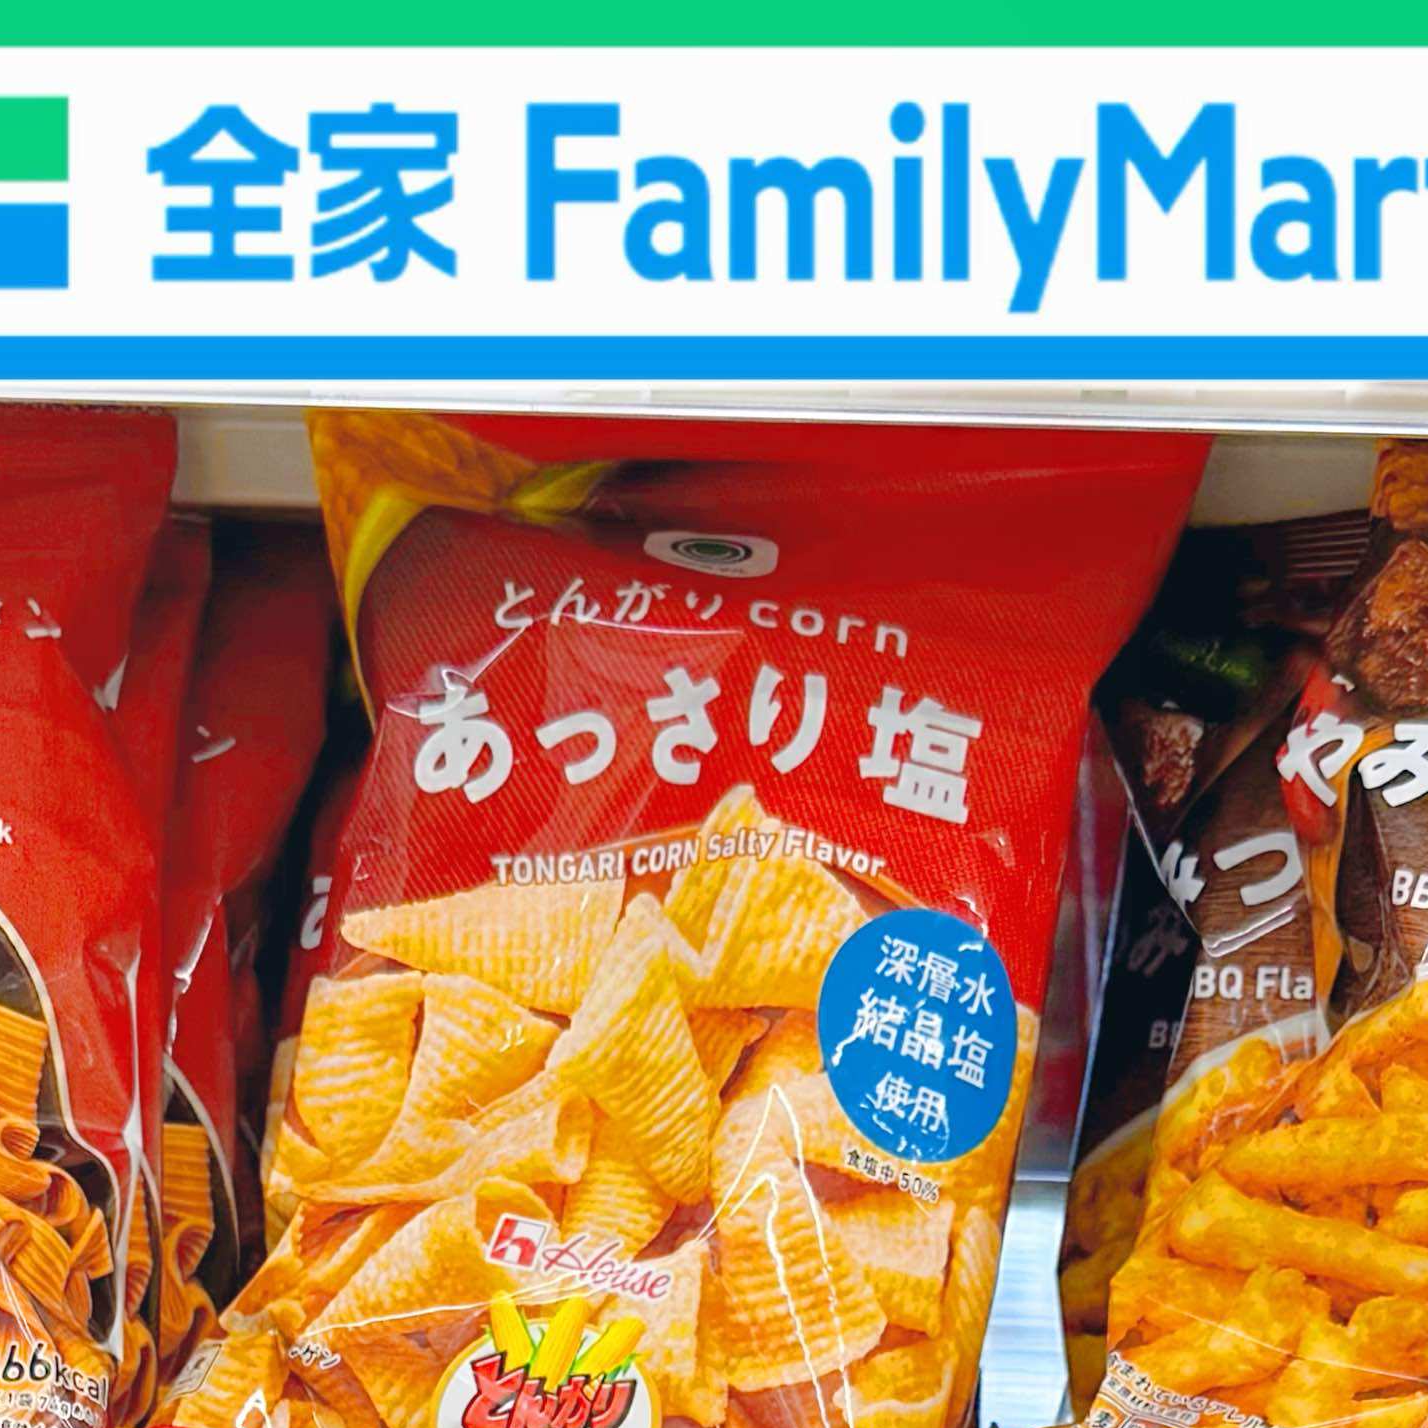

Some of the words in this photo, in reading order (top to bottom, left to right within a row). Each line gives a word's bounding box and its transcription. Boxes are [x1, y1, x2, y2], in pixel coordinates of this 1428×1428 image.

[413, 664, 984, 826] あっさり塩
[493, 851, 626, 887] TONGARI
[631, 837, 702, 876] CORN
[706, 828, 776, 867] Salty
[784, 827, 889, 881] Flavor
[875, 934, 996, 1017] 深層水
[854, 986, 994, 1090] 結晶塩
[870, 1070, 949, 1134] 使用
[543, 1234, 673, 1300] House
